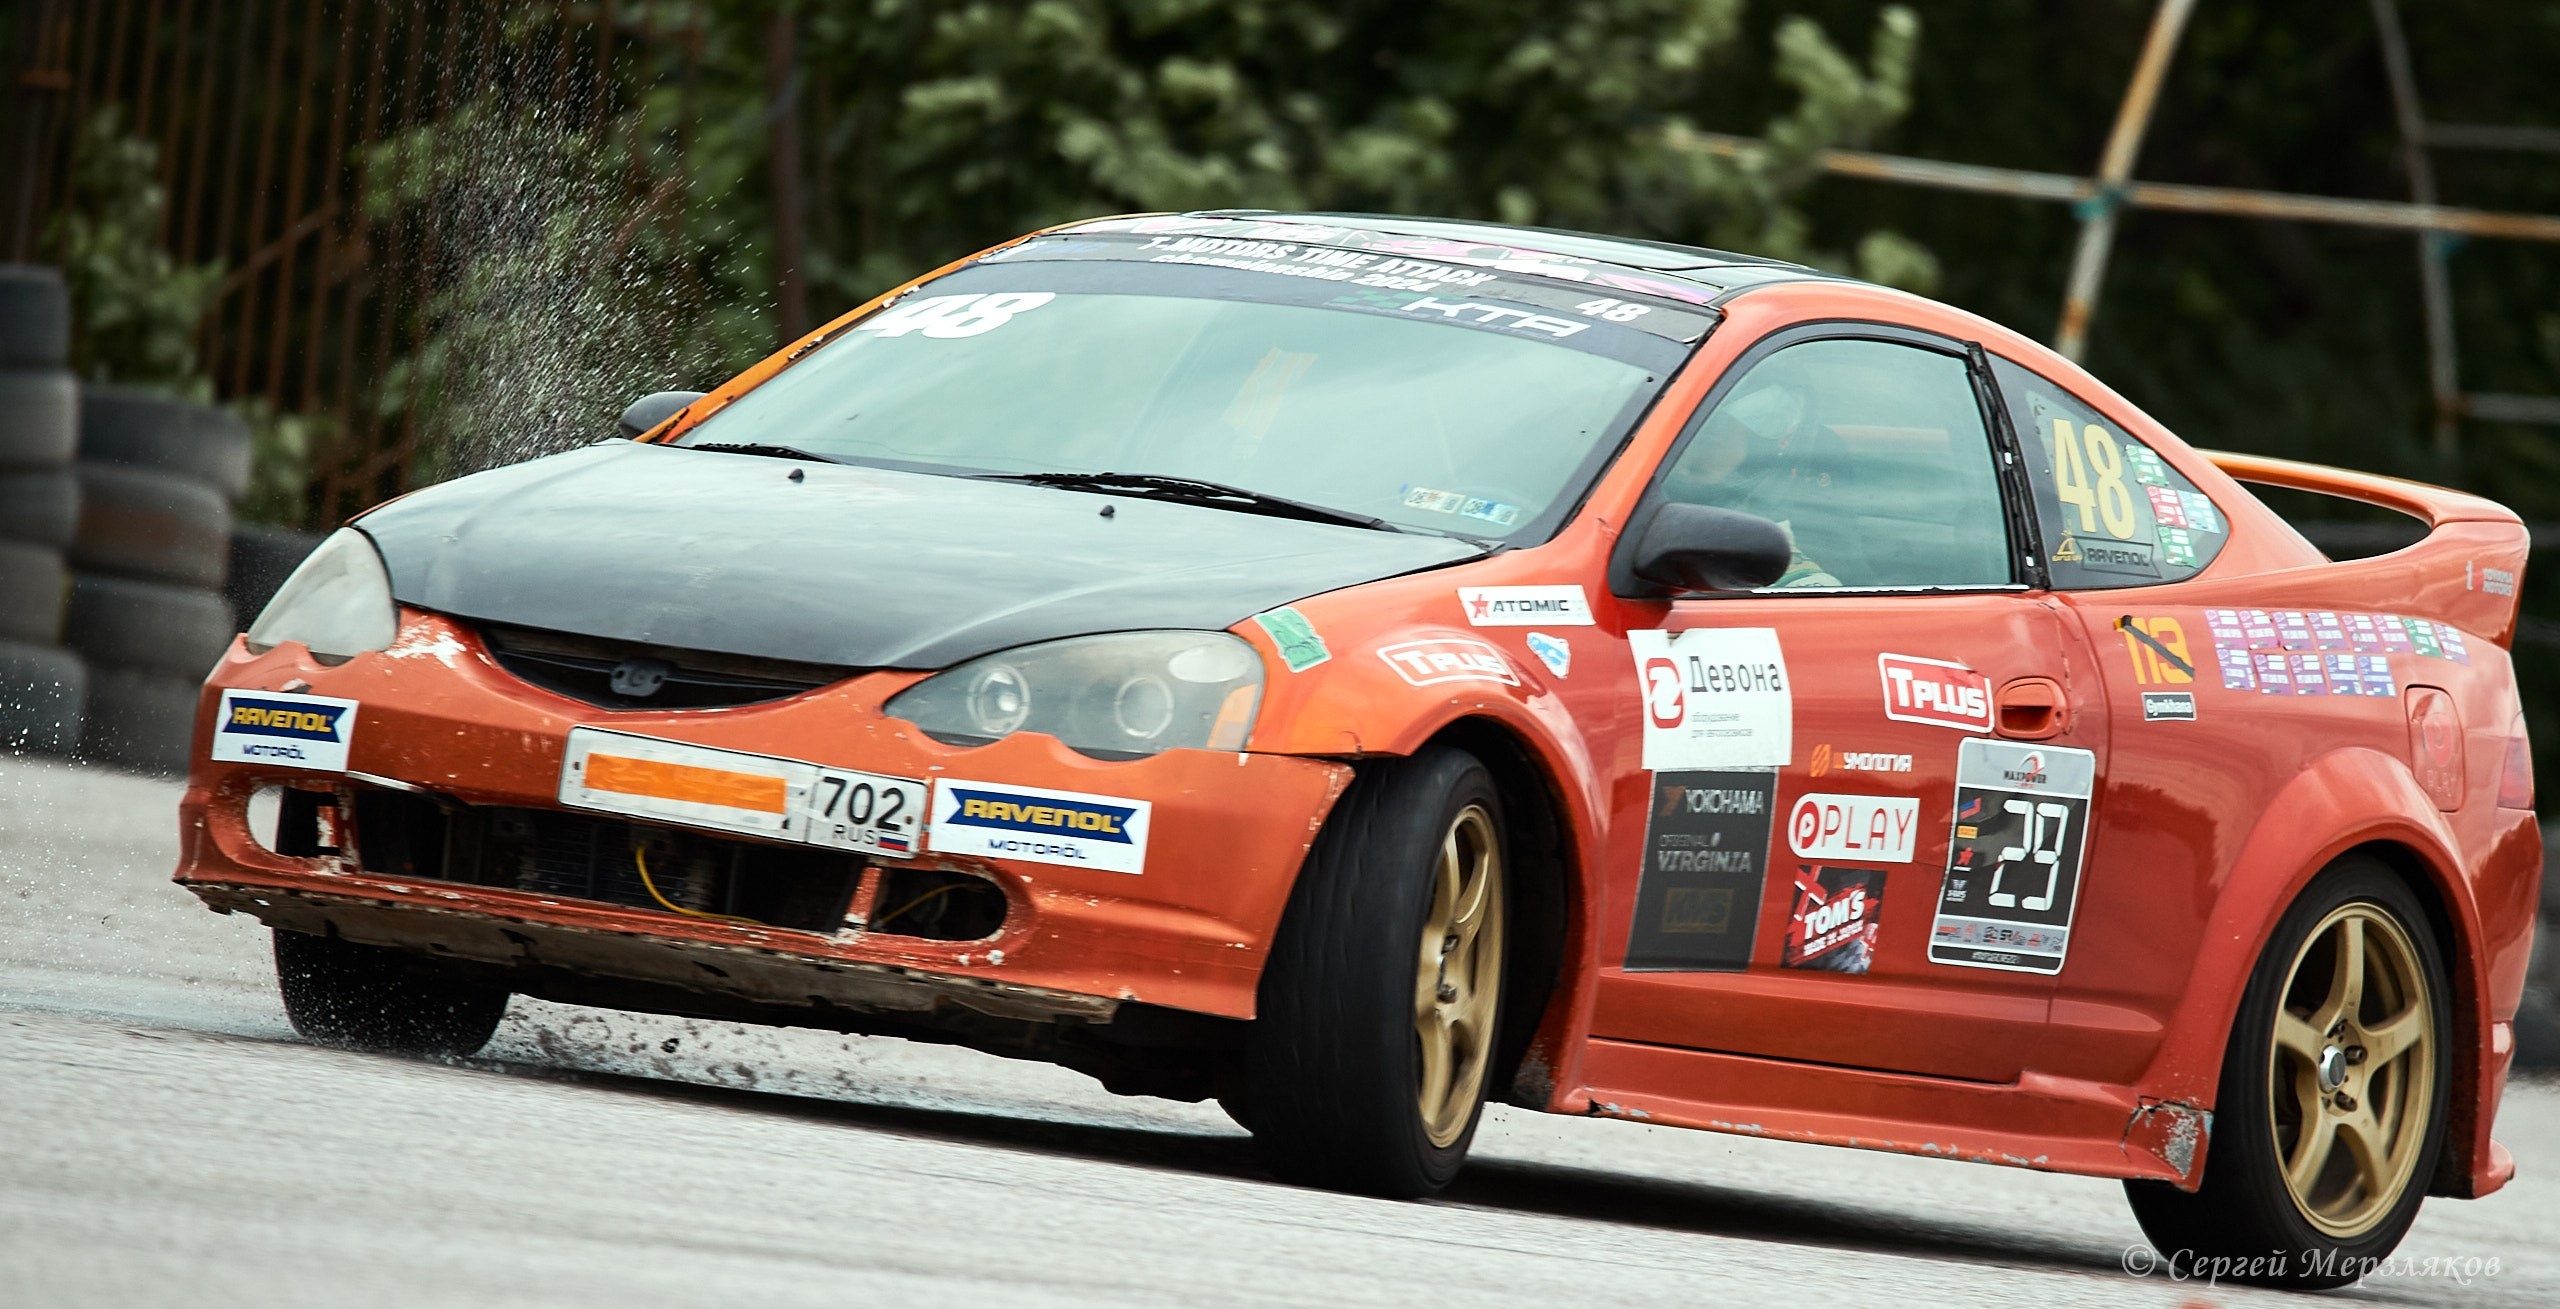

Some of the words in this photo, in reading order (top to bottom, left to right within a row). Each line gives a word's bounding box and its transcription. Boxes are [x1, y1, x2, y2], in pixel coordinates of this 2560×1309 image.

[1292, 247, 1380, 269] TIME
[1366, 258, 1498, 287] ATTACK
[858, 291, 1056, 339] 48
[1400, 296, 1592, 338] KTA
[1575, 298, 1652, 322] 48
[2053, 418, 2136, 540] 48
[2087, 548, 2150, 567] RAVENOL
[1493, 599, 1570, 613] ATOMIC
[2113, 616, 2194, 685] 113
[1689, 655, 1782, 693] Девона
[232, 706, 332, 733] RAVENOL
[2145, 699, 2193, 716] Gymkhana
[822, 775, 906, 832] 702
[964, 799, 1121, 835] RAVENOL
[1685, 789, 1765, 815] YOKOHAMA
[833, 824, 876, 846] RUS
[988, 837, 1089, 860] MOTORÖL
[1657, 850, 1753, 873] VIRGINIA
[1988, 799, 2070, 911] 29
[1804, 889, 1867, 940] TOM'S
